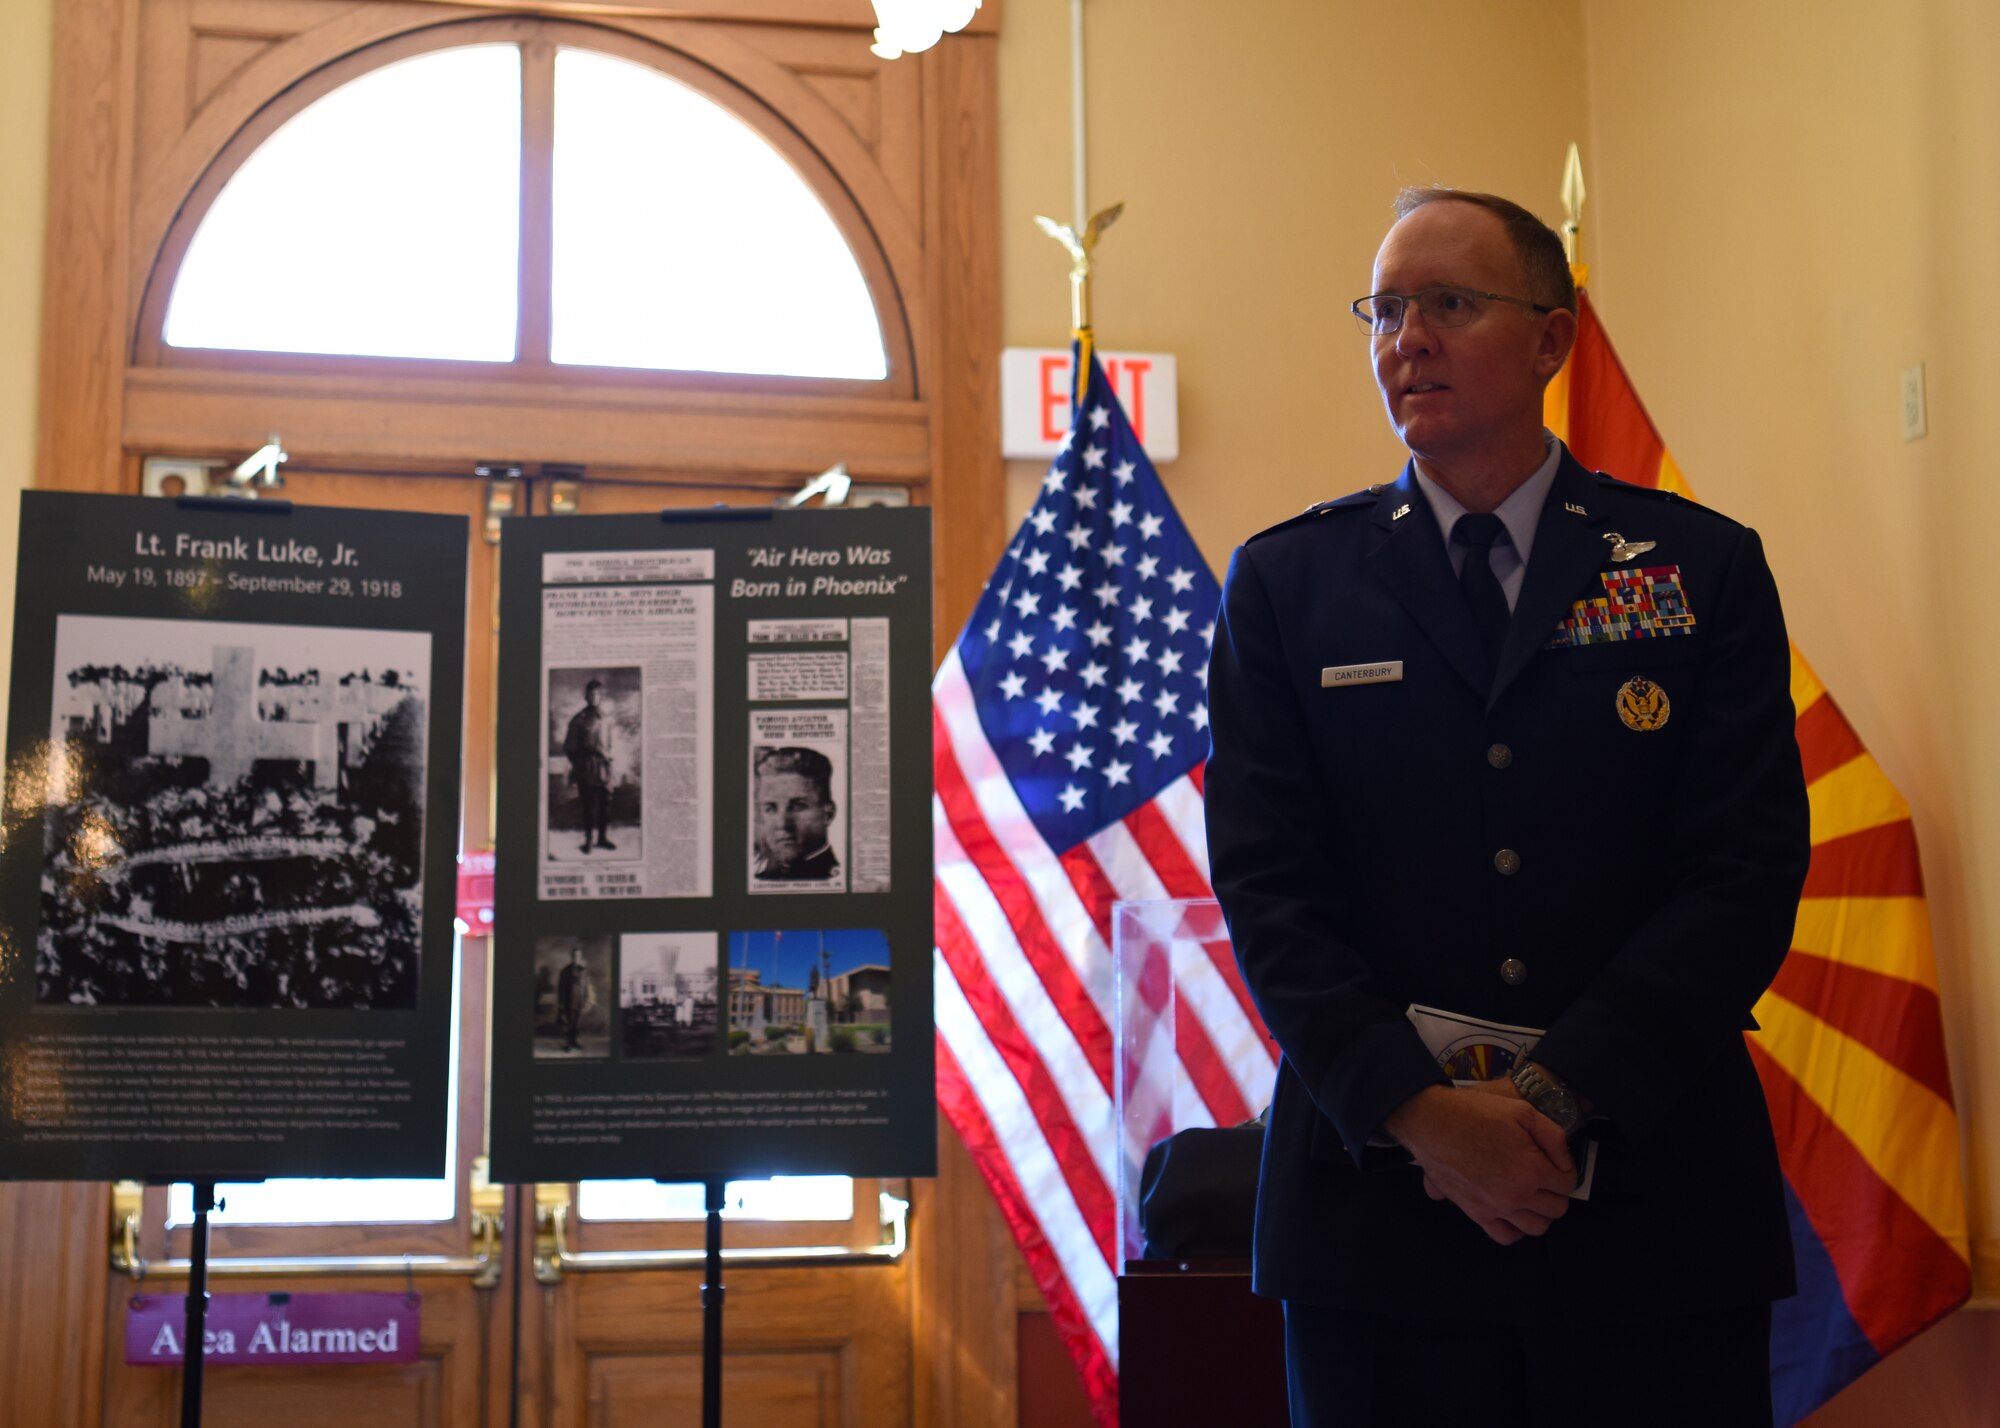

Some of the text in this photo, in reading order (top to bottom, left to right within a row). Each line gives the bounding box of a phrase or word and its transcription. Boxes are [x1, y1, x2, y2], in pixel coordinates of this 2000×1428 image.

[1040, 356, 1152, 446] ET
[135, 531, 360, 567] Lt. Frank Luke, Jr.
[790, 547, 841, 567] Hero
[846, 546, 892, 566] Was
[87, 565, 126, 586] May
[132, 567, 157, 587] 19,
[227, 573, 324, 595] September
[328, 578, 354, 597] 29,
[361, 580, 403, 599] 1918
[730, 579, 781, 598] Born
[786, 577, 807, 597] in
[1334, 667, 1393, 681] CANTERBURY
[151, 1318, 400, 1356] Aea Alarmed
